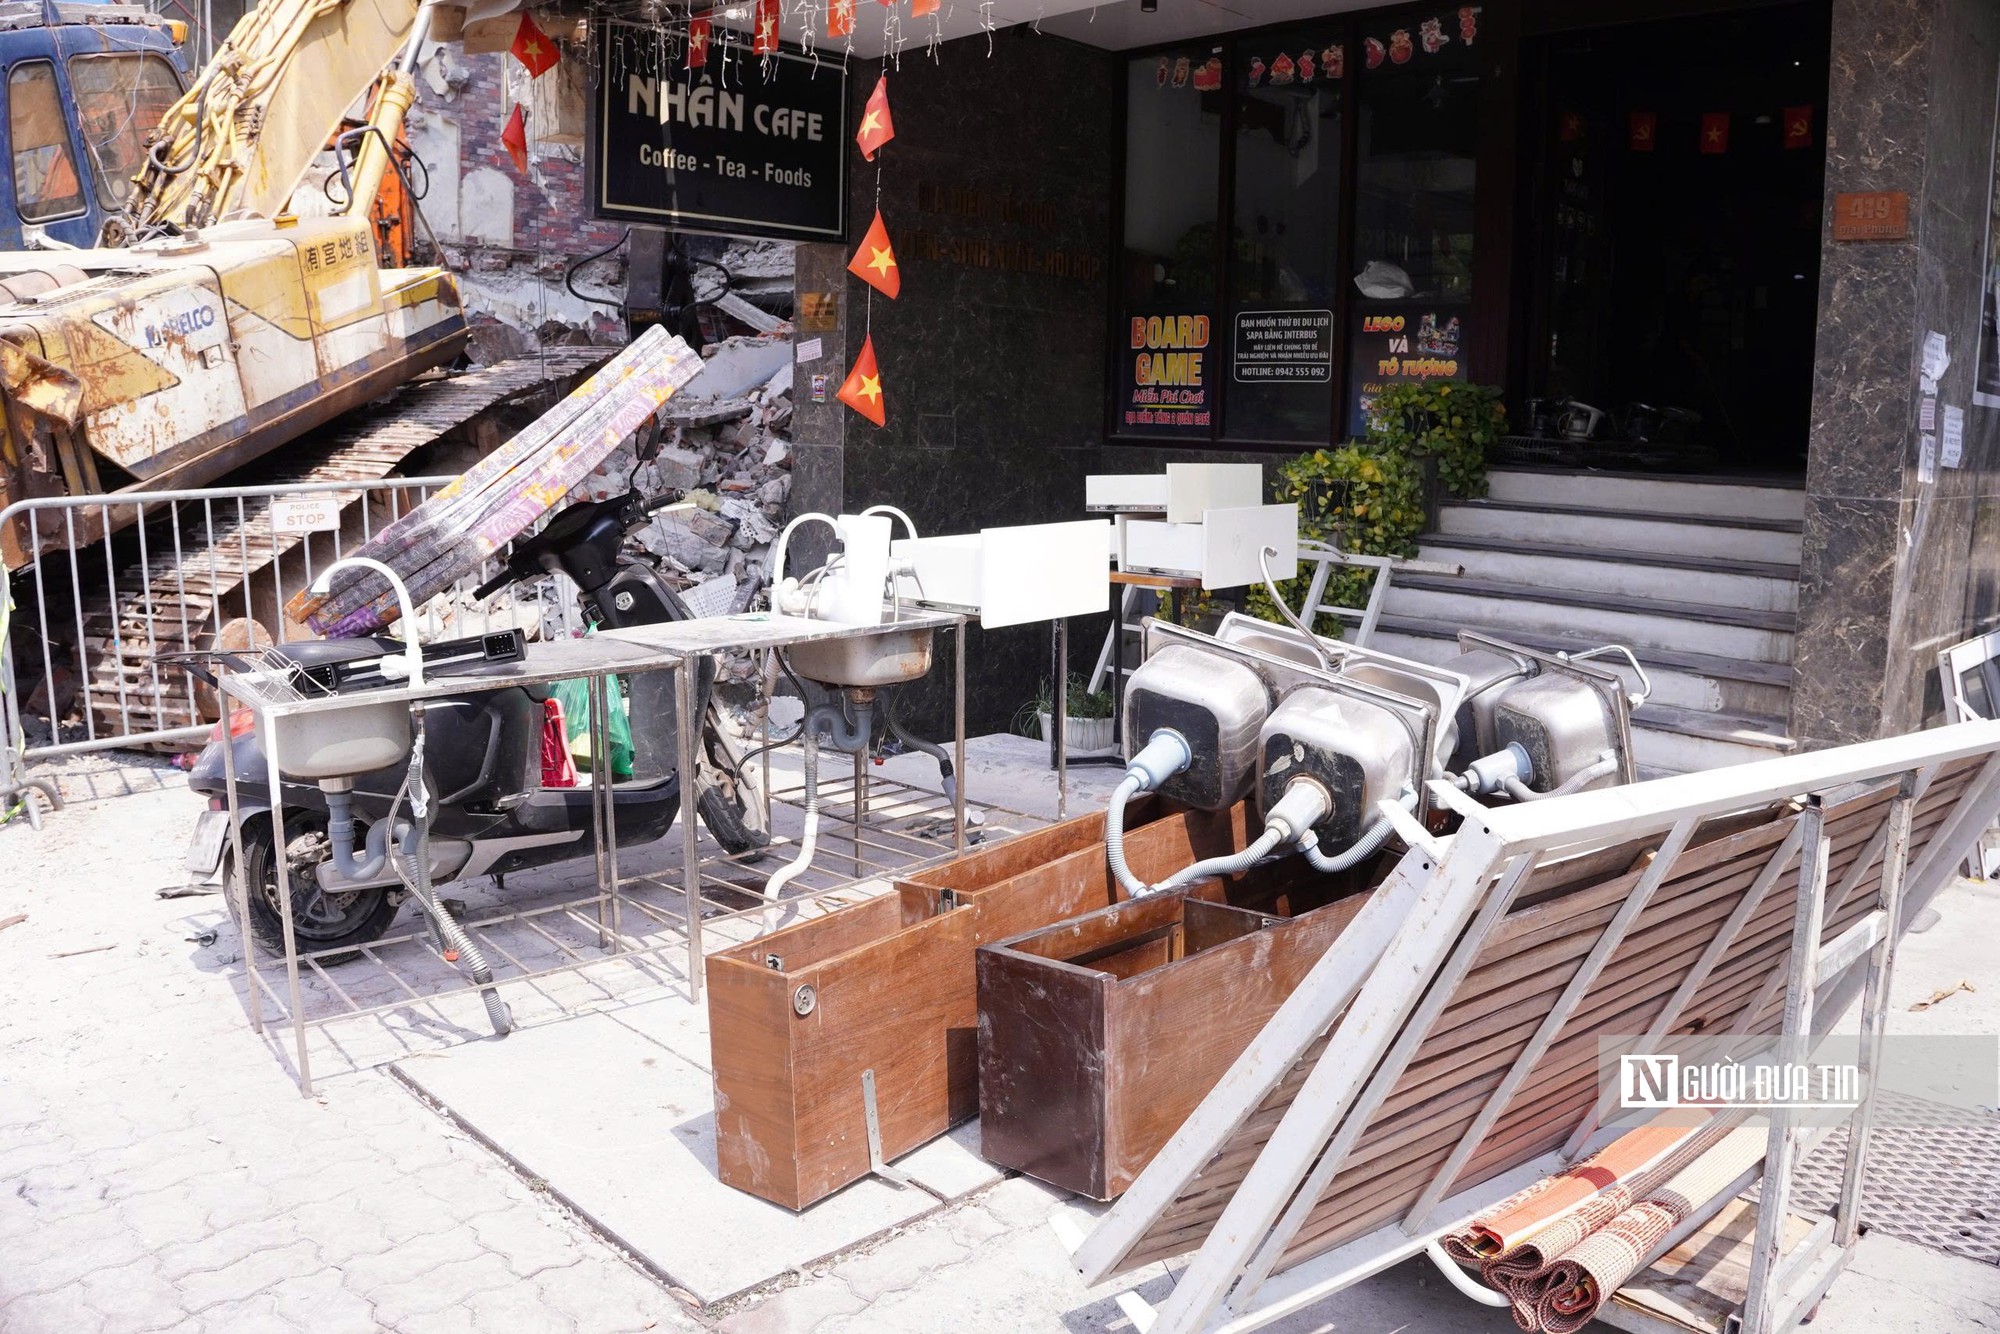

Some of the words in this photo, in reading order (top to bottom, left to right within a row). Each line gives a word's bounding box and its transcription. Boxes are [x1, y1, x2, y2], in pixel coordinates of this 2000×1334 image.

[628, 74, 745, 132] NHÂN
[753, 103, 823, 141] CAFE
[639, 143, 697, 171] Coffee
[716, 155, 746, 179] Tea
[765, 162, 812, 188] Foods
[1849, 197, 1891, 220] 419
[1240, 319, 1255, 329] BẠN
[1256, 316, 1276, 327] MUỐN
[1293, 318, 1301, 326] ĐI
[1302, 318, 1312, 326] DU
[1313, 317, 1329, 328] LỊCH
[1362, 315, 1405, 332] LEGO
[1131, 315, 1210, 349] BOARD
[1246, 331, 1263, 340] SAPA
[1284, 330, 1317, 339] INTERBUS
[1388, 334, 1409, 353] VÀ
[1135, 352, 1203, 386] GAME
[1242, 368, 1273, 376] HOTLINE:
[1275, 368, 1293, 376] 0942
[1295, 368, 1310, 376] 555
[1311, 368, 1325, 376] 092
[1378, 356, 1400, 376] TÔ
[1401, 357, 1458, 380] TƯỢNG
[1160, 389, 1179, 404] Phí
[289, 503, 320, 511] POLICE
[287, 513, 326, 526] STOP
